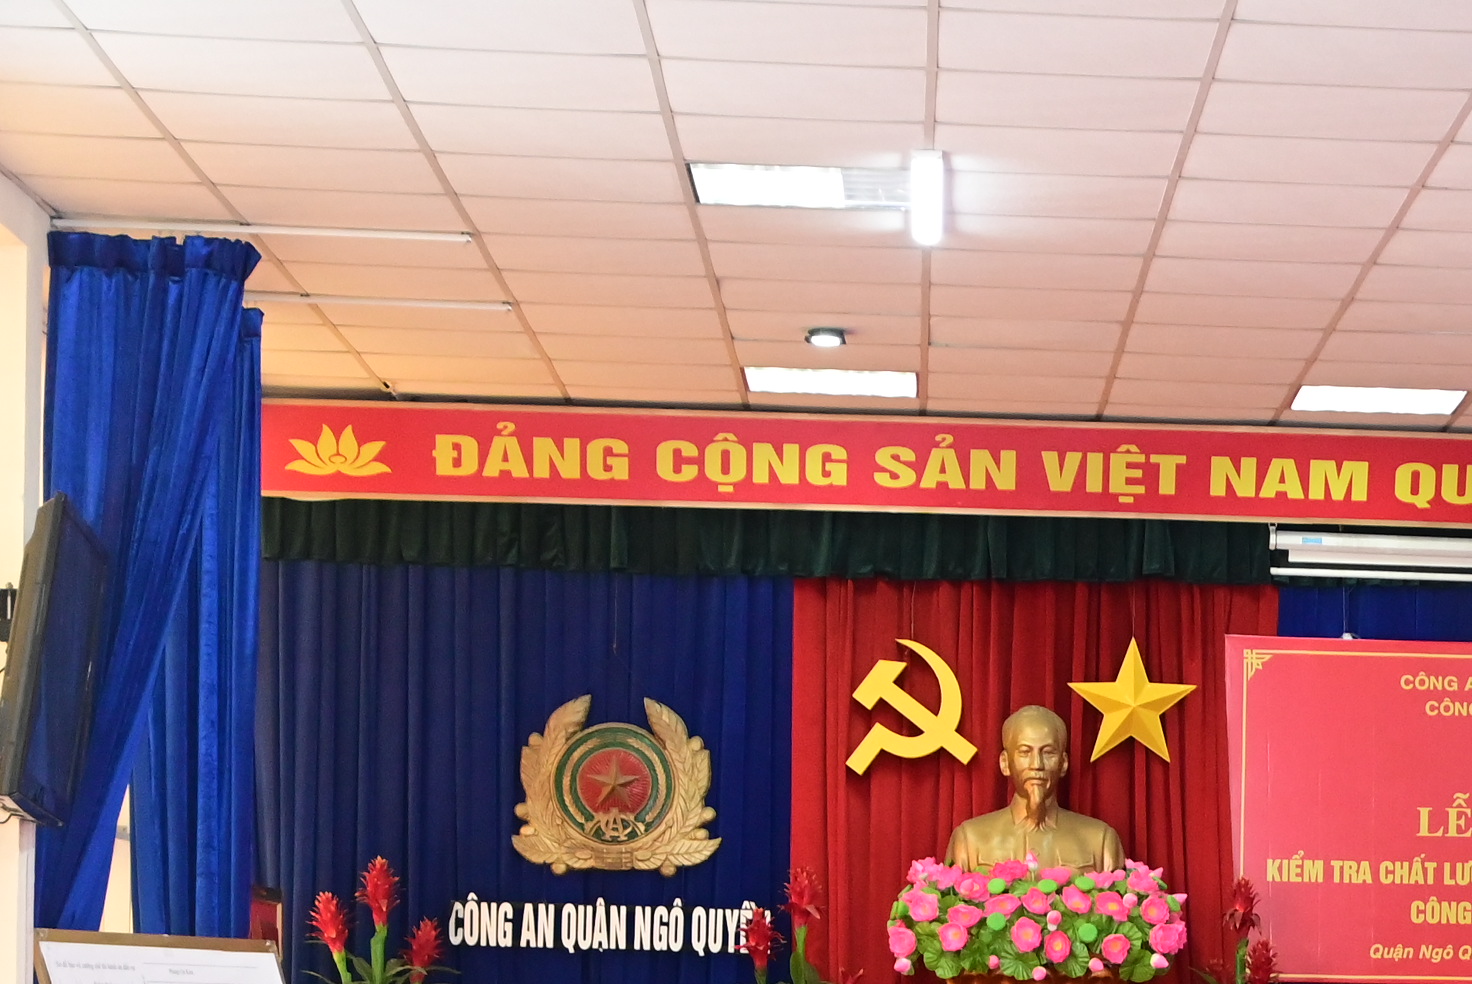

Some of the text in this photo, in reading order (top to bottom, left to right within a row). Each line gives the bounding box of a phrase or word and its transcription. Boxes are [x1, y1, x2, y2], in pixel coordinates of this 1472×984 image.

[433, 422, 629, 480] ĐẢNG
[657, 433, 848, 493] CỘNG
[874, 434, 1017, 491] SẢN
[1043, 444, 1187, 503] VIỆT
[1210, 456, 1369, 502] NAM
[1400, 671, 1458, 691] CÔNG
[1416, 792, 1472, 838] LỄ
[1266, 849, 1324, 883] KIỂM
[1330, 860, 1373, 884] TRA
[1379, 853, 1438, 885] CHẤT
[448, 892, 772, 957] CÔNG AN QUẬN NGÔ QUYỀ
[1410, 896, 1472, 925] CÔNG
[1369, 943, 1414, 962] Quận
[1419, 944, 1454, 963] Ngô
